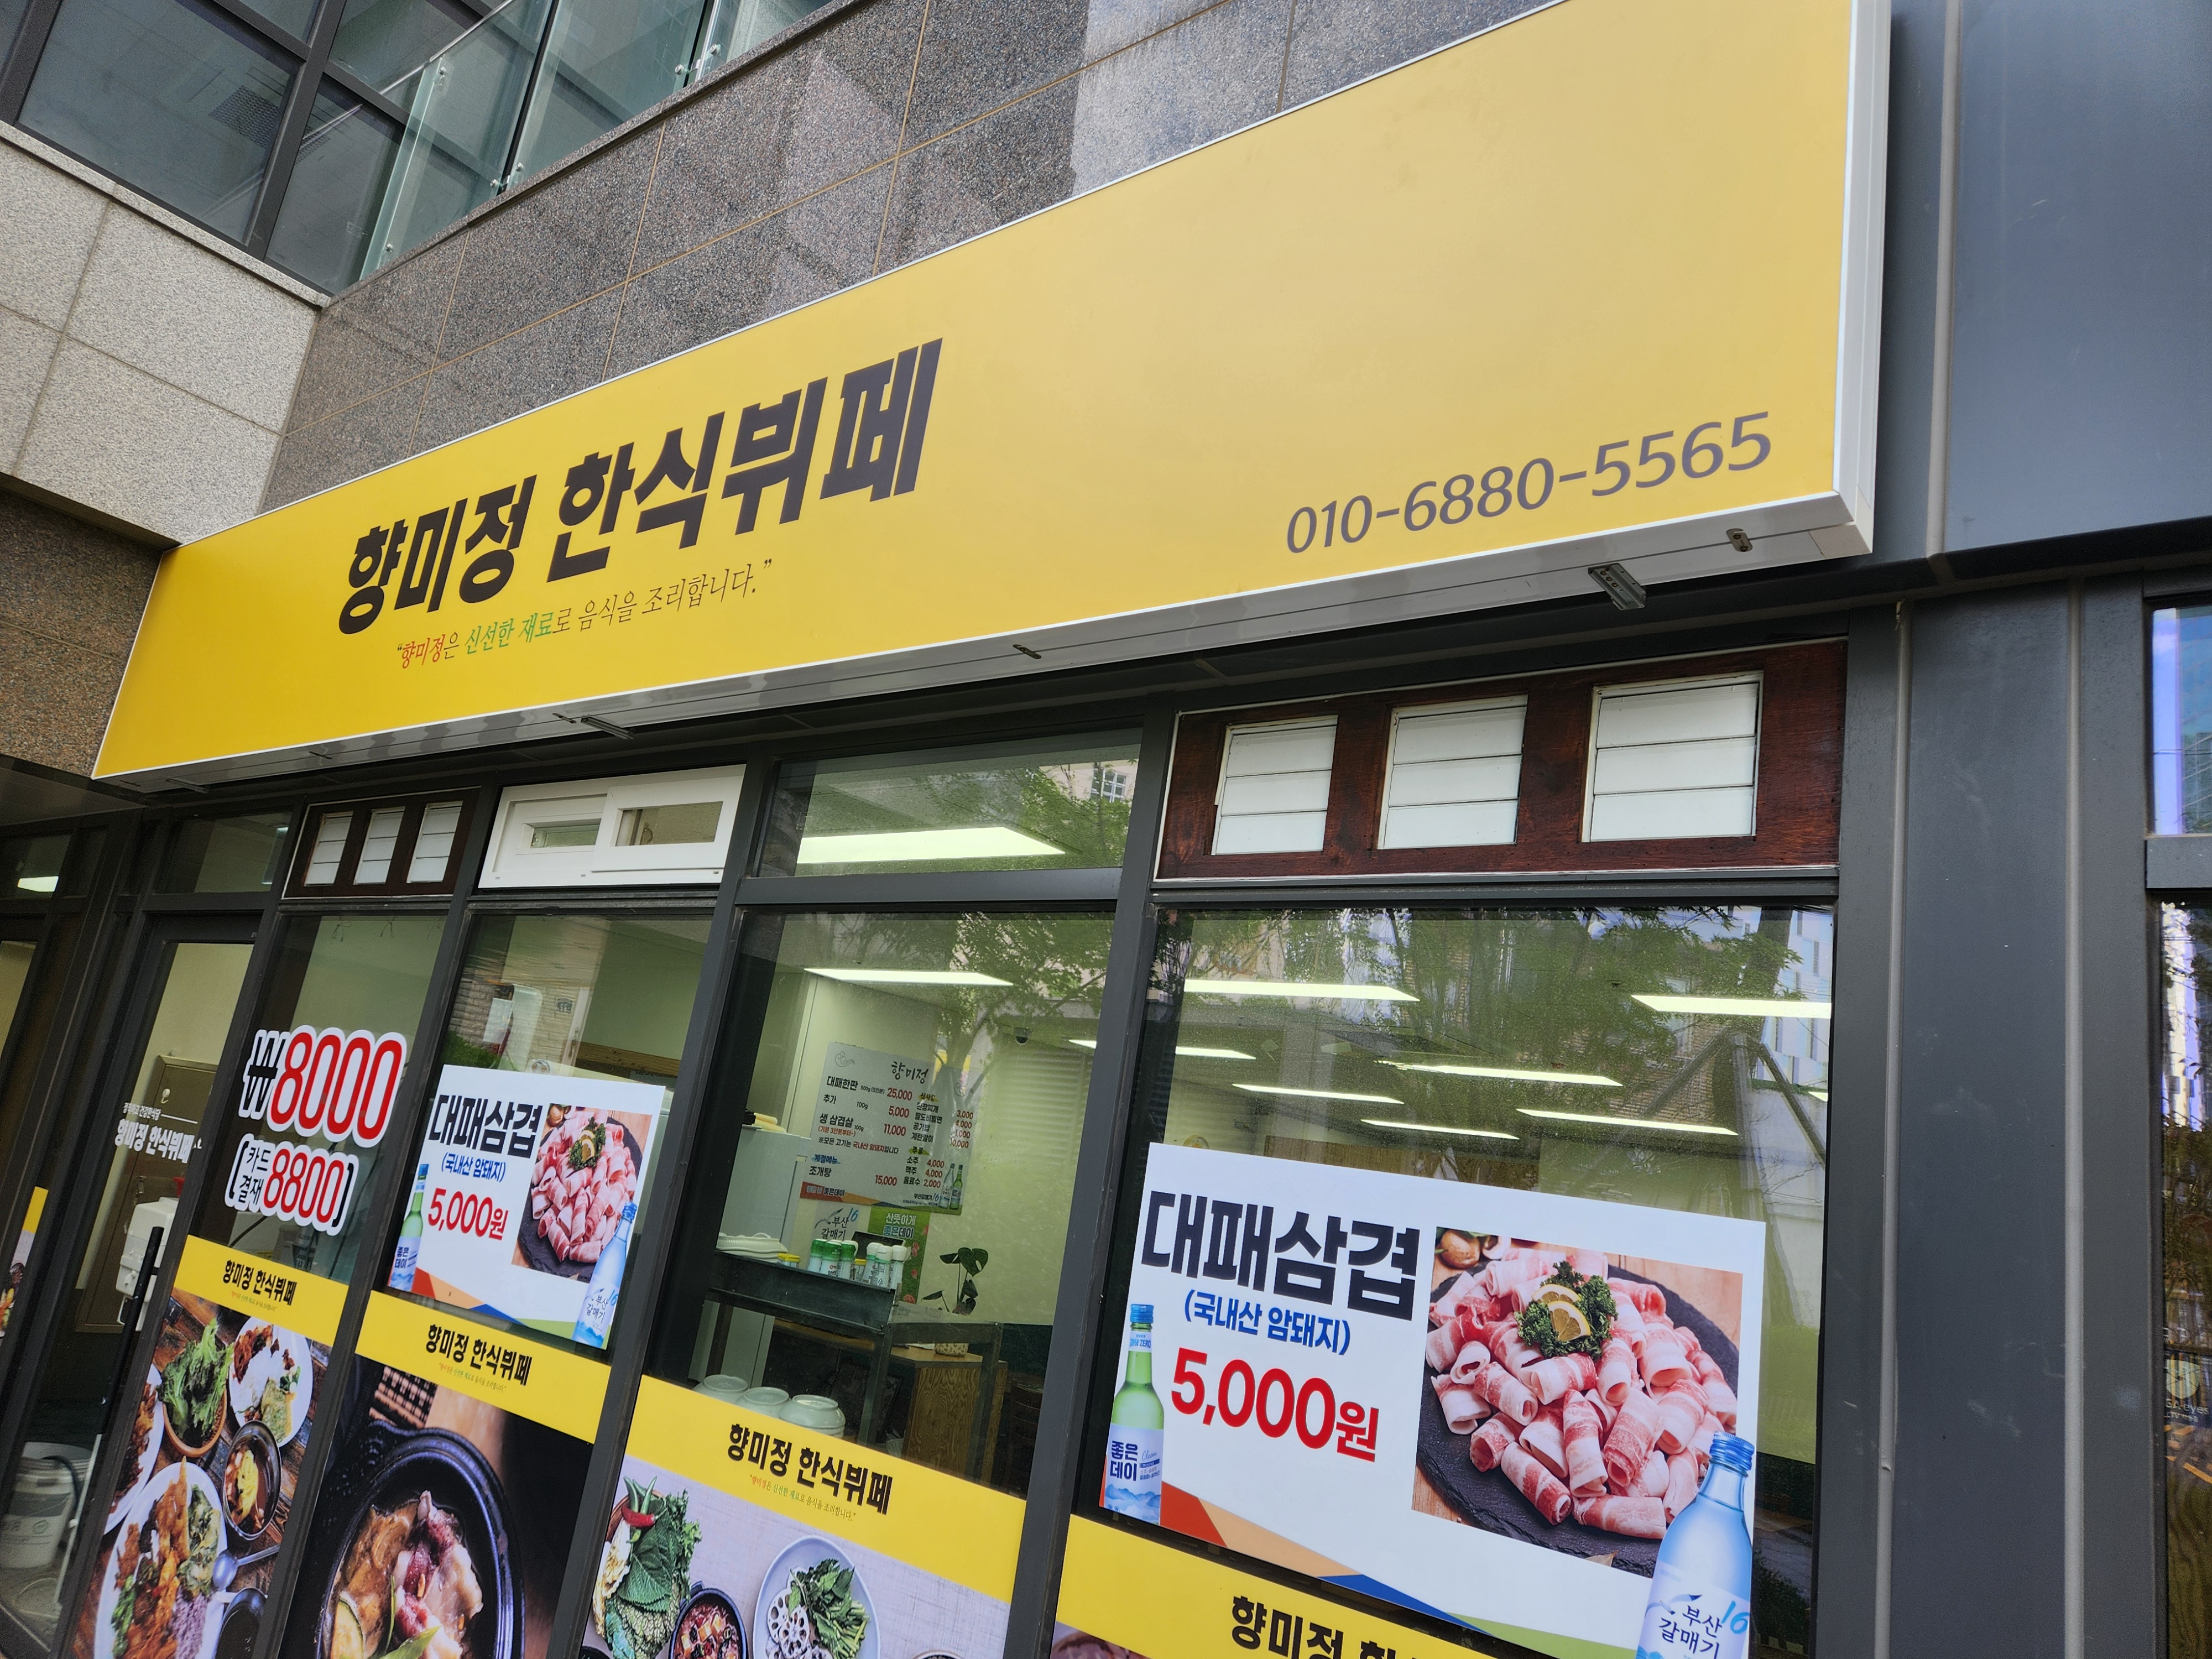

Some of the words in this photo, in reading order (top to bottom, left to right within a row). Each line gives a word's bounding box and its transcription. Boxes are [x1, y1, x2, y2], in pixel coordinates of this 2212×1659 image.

[337, 475, 538, 635] 향미정
[545, 337, 943, 583] 한식뷔페
[1286, 411, 1771, 554] 010-6880-5565
[397, 632, 460, 669] “향미정은
[465, 620, 515, 655] 신선한
[518, 607, 572, 643] 재료로
[578, 591, 638, 632] 음식을
[641, 559, 772, 614] 조리합니다.”
[891, 1061, 929, 1084] 향미정
[887, 1087, 912, 1101] 25,000
[823, 1094, 837, 1104] 추가
[857, 1101, 868, 1110] 100g
[888, 1105, 910, 1118] 5,000
[957, 1110, 973, 1119] 3,000
[428, 1094, 544, 1159] 대패삼겹
[818, 1125, 830, 1134] (기본
[820, 1113, 828, 1124] 생
[830, 1114, 854, 1128] 삼겹살
[884, 1123, 906, 1136] 11,000
[913, 1122, 931, 1132] 공기밥
[955, 1129, 971, 1139] 1,000
[915, 1112, 942, 1124] 팔도비빔면
[955, 1120, 972, 1129] 4,000
[835, 1139, 852, 1147] 고기는
[852, 1141, 869, 1151] 국내산
[869, 1144, 899, 1154] 암돼지입니다
[911, 1132, 934, 1143] 계란말이
[950, 1138, 969, 1148] 10,000
[441, 1152, 473, 1176] (국내산
[473, 1157, 506, 1183] 암돼지)
[905, 1166, 917, 1175] 맥주
[925, 1169, 943, 1178] 4,000
[906, 1156, 919, 1165] 소주
[927, 1159, 945, 1168] 4,000
[809, 1166, 832, 1177] 조개탕
[875, 1175, 898, 1186] 15,000
[903, 1176, 920, 1186] 음료수
[924, 1179, 941, 1188] 2,000
[823, 1187, 846, 1197] 좋은데이
[427, 1187, 509, 1241] 5,000원
[832, 1216, 849, 1229] 부산
[848, 1207, 859, 1222] 16
[821, 1228, 847, 1241] 갈매기
[883, 1225, 914, 1239] 좋은데이
[1140, 1190, 1421, 1322] 대패삼겹
[223, 1260, 254, 1290] 향미정
[253, 1270, 298, 1306] 한식뷔페
[596, 1294, 608, 1310] 부산
[586, 1303, 606, 1324] 갈매기
[1184, 1289, 1263, 1335] (국내산
[1267, 1305, 1351, 1356] 암돼지)
[426, 1324, 469, 1363] 향미정
[469, 1339, 533, 1386] 한식뷔페
[1139, 1339, 1151, 1349] ZERO
[1171, 1347, 1379, 1463] 5,000원
[1111, 1440, 1138, 1462] 좋은
[1142, 1449, 1157, 1461] Clean
[727, 1423, 792, 1477] 향미정
[796, 1447, 893, 1515] 한식뷔페
[1110, 1459, 1138, 1481] 데이
[773, 1484, 789, 1497] 신선한
[806, 1496, 823, 1510] 음식을
[1682, 1604, 1723, 1639] 부산
[1720, 1600, 1750, 1634] 16
[1658, 1616, 1720, 1659] 갈매기
